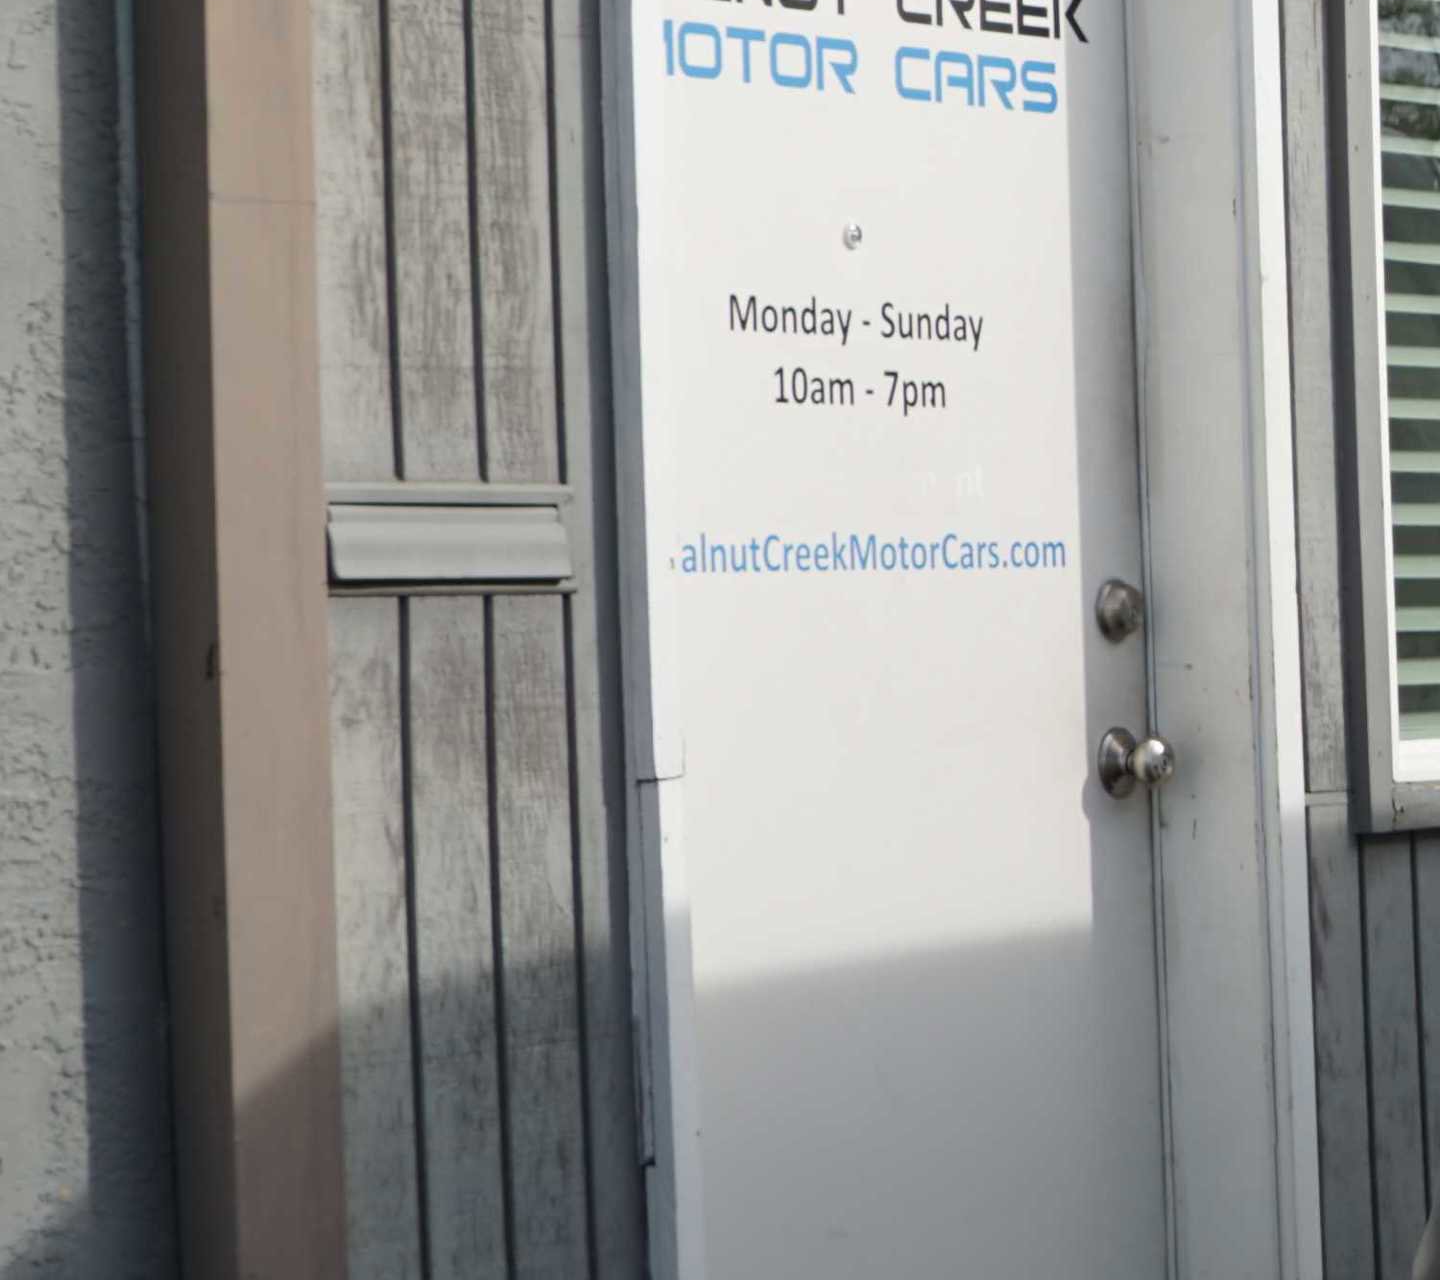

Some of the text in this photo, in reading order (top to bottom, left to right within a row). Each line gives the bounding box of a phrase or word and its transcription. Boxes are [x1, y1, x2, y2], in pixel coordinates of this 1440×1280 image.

[662, 19, 1059, 115] OTOR CARS
[728, 293, 853, 347] Monday
[880, 300, 984, 352] Sunday
[773, 366, 855, 406] 10am
[883, 370, 947, 417] 7pm
[680, 531, 1067, 574] alnutCreekMotorCars.com
